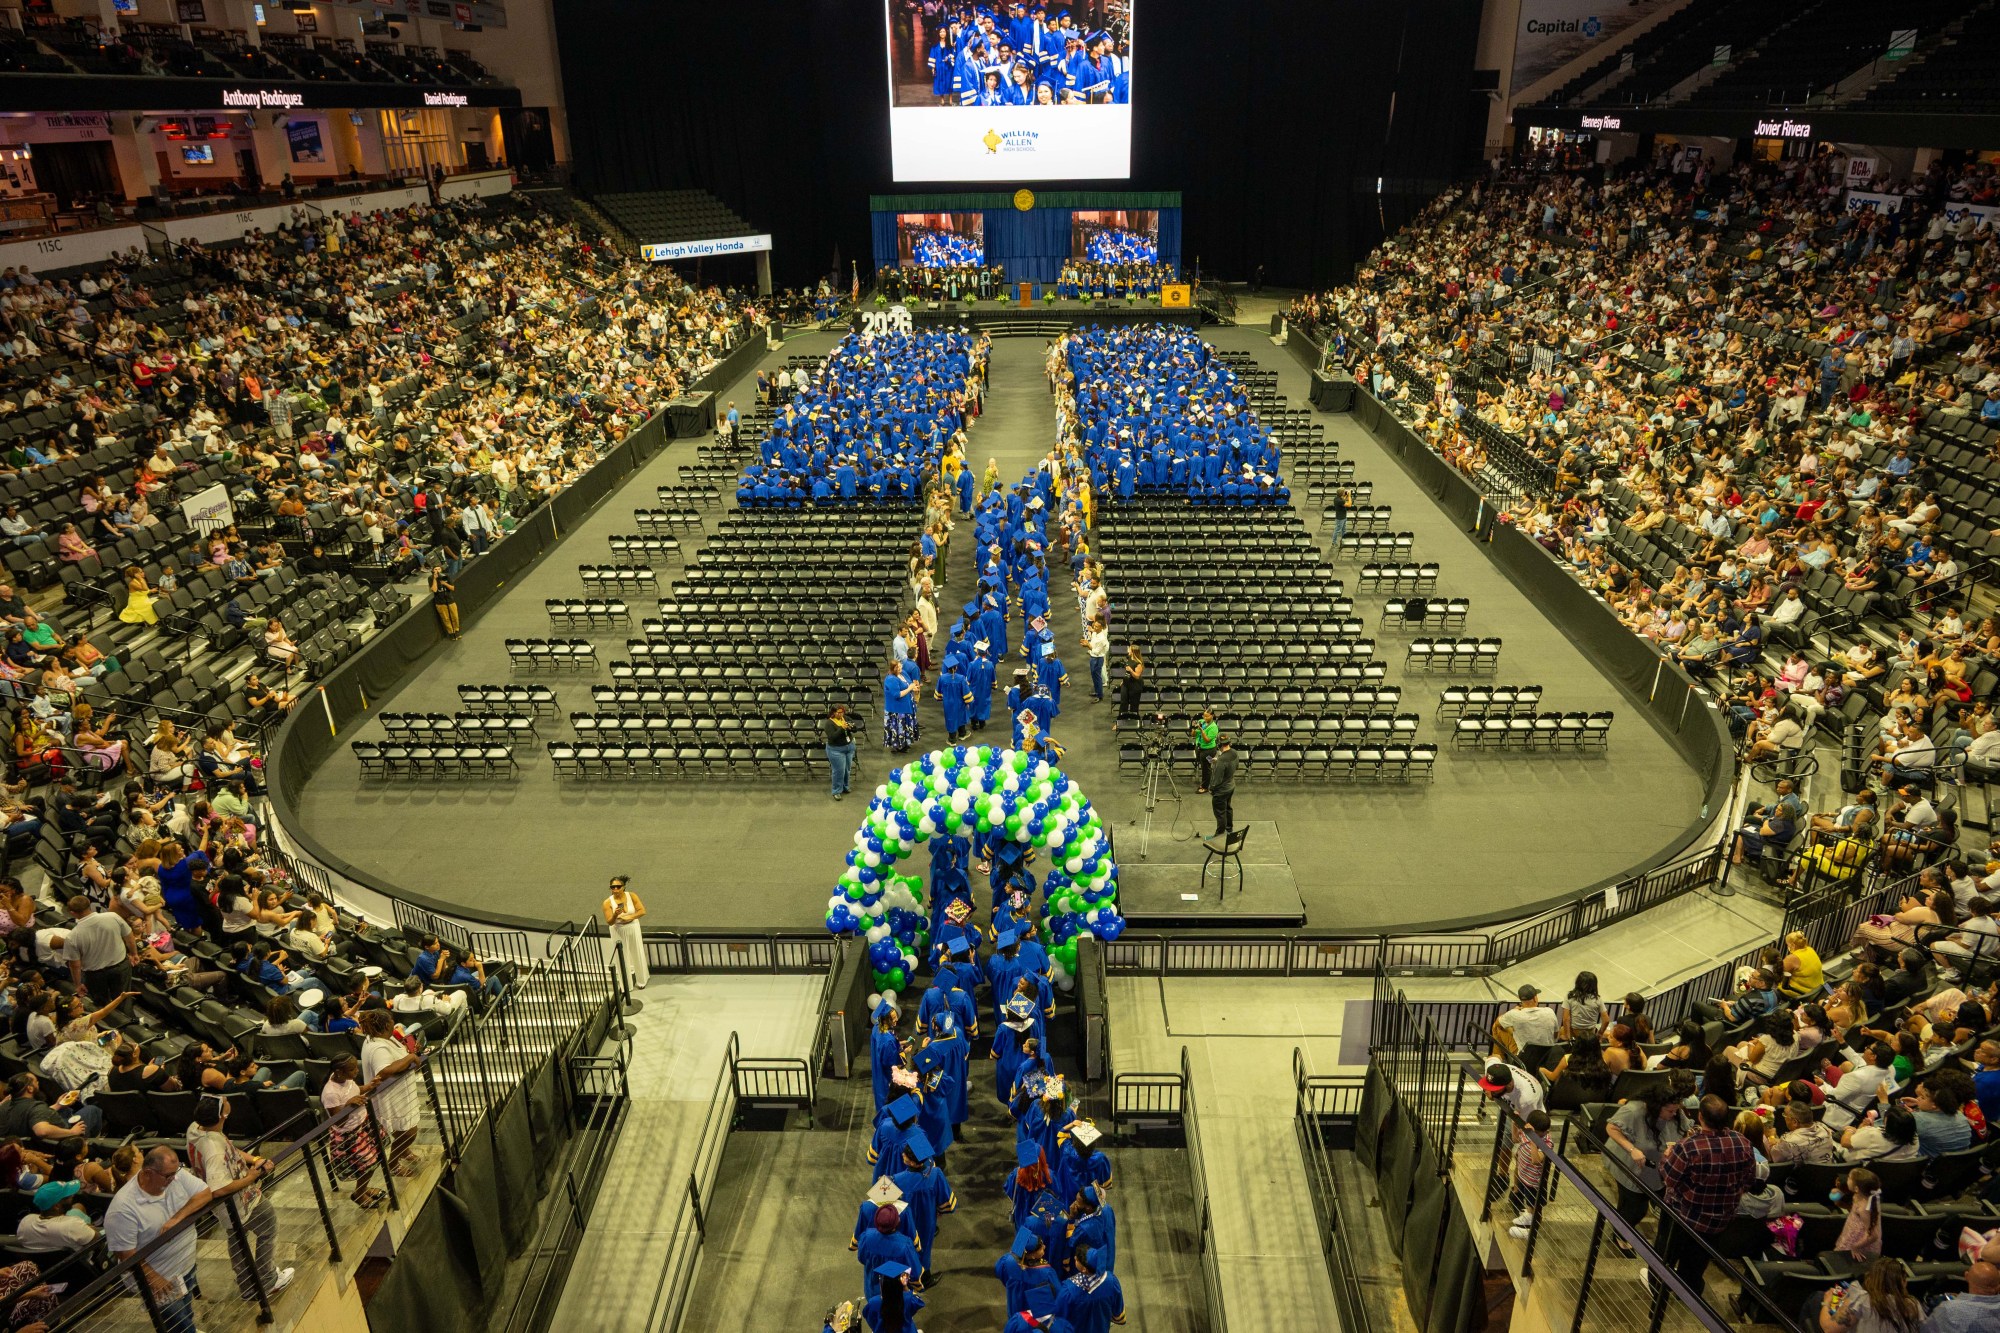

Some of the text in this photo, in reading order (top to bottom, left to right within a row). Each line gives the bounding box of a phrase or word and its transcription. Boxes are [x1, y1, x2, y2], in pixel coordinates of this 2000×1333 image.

[1527, 19, 1580, 36] Capital
[223, 89, 304, 109] Anthony Rodriguez
[424, 92, 468, 108] Daniel Rodriguez
[45, 116, 64, 127] THE
[1581, 115, 1621, 131] Hennesy Rivera
[1754, 119, 1811, 137] Jovier Rivera
[1001, 130, 1039, 139] WILLIAM
[1006, 138, 1032, 146] ALLEN
[236, 212, 254, 223] 116C
[1946, 209, 1985, 227] SCT
[37, 239, 63, 254] 115C
[655, 246, 685, 258] Lehigh
[687, 243, 714, 255] Valley
[715, 241, 744, 251] Honda
[861, 311, 913, 337] 2026
